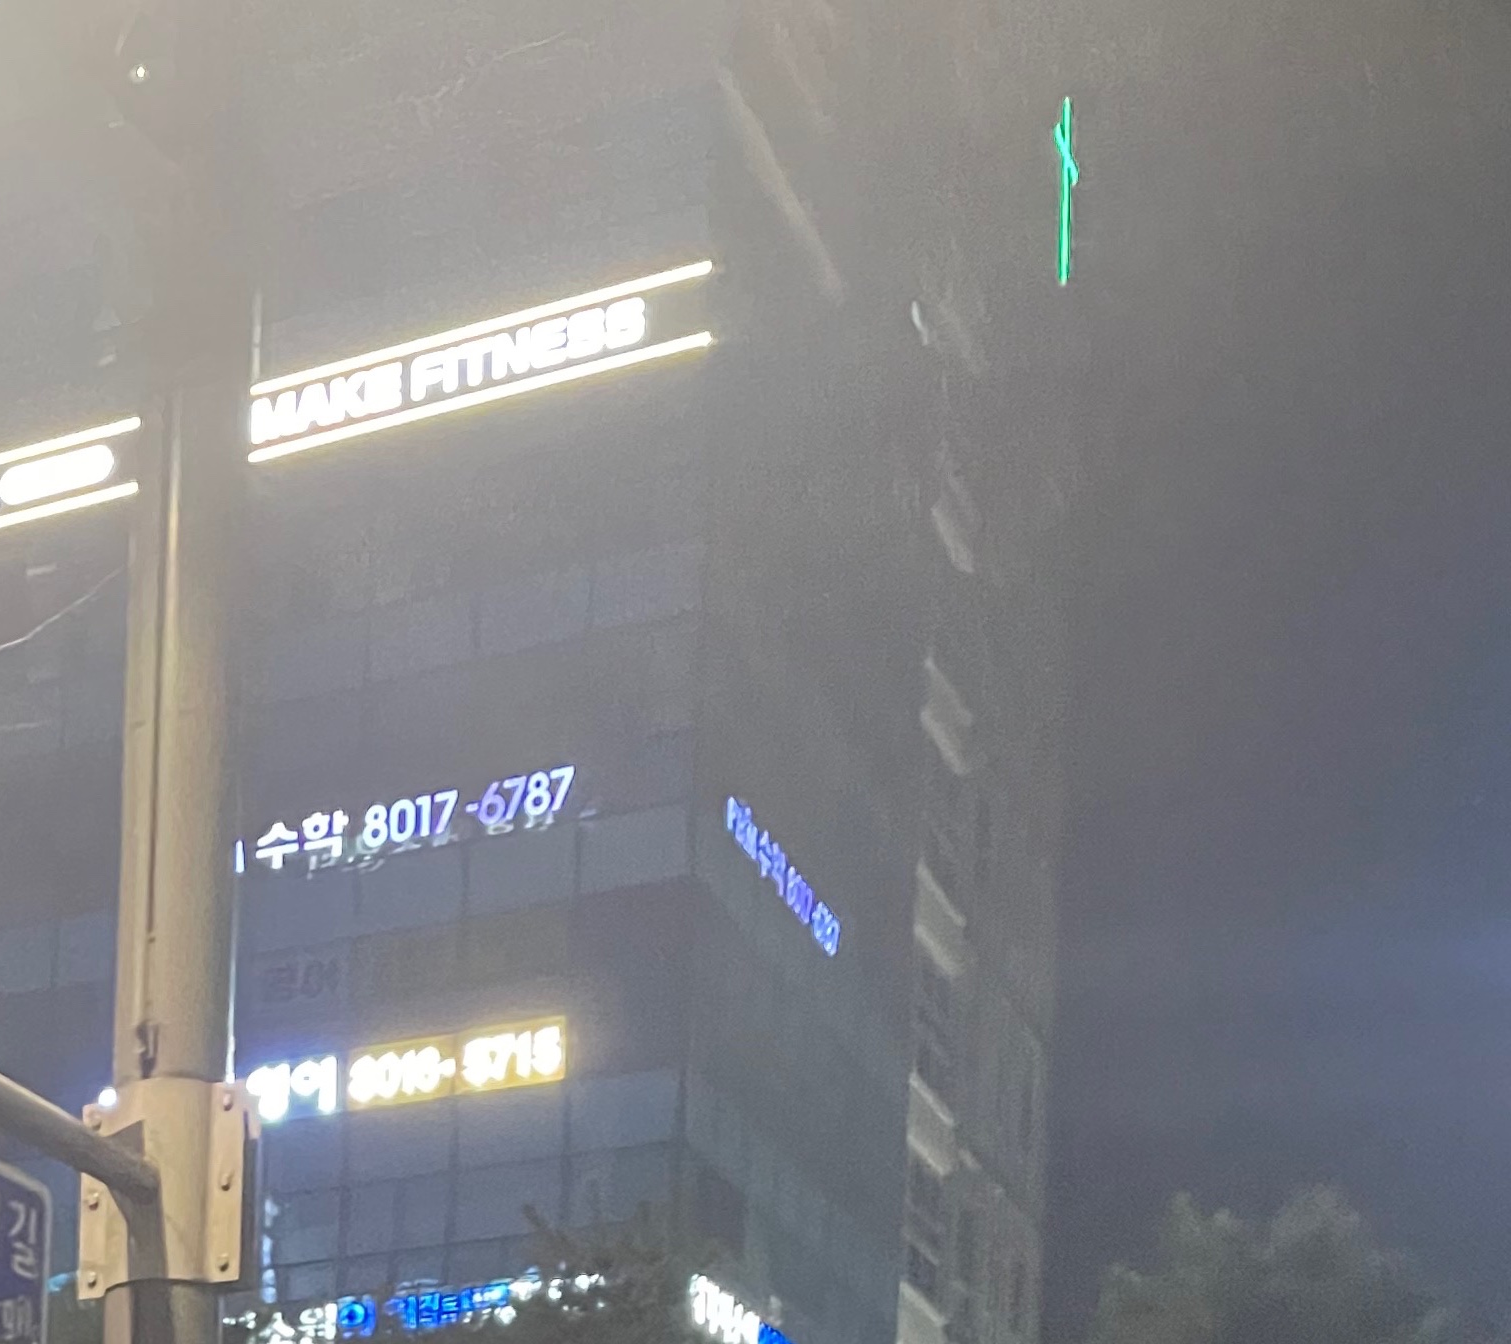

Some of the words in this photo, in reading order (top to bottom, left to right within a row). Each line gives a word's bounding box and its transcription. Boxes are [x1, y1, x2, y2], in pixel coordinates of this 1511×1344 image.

[250, 361, 403, 445] MAKE
[409, 296, 647, 402] FITNESS
[255, 808, 350, 870] 수학
